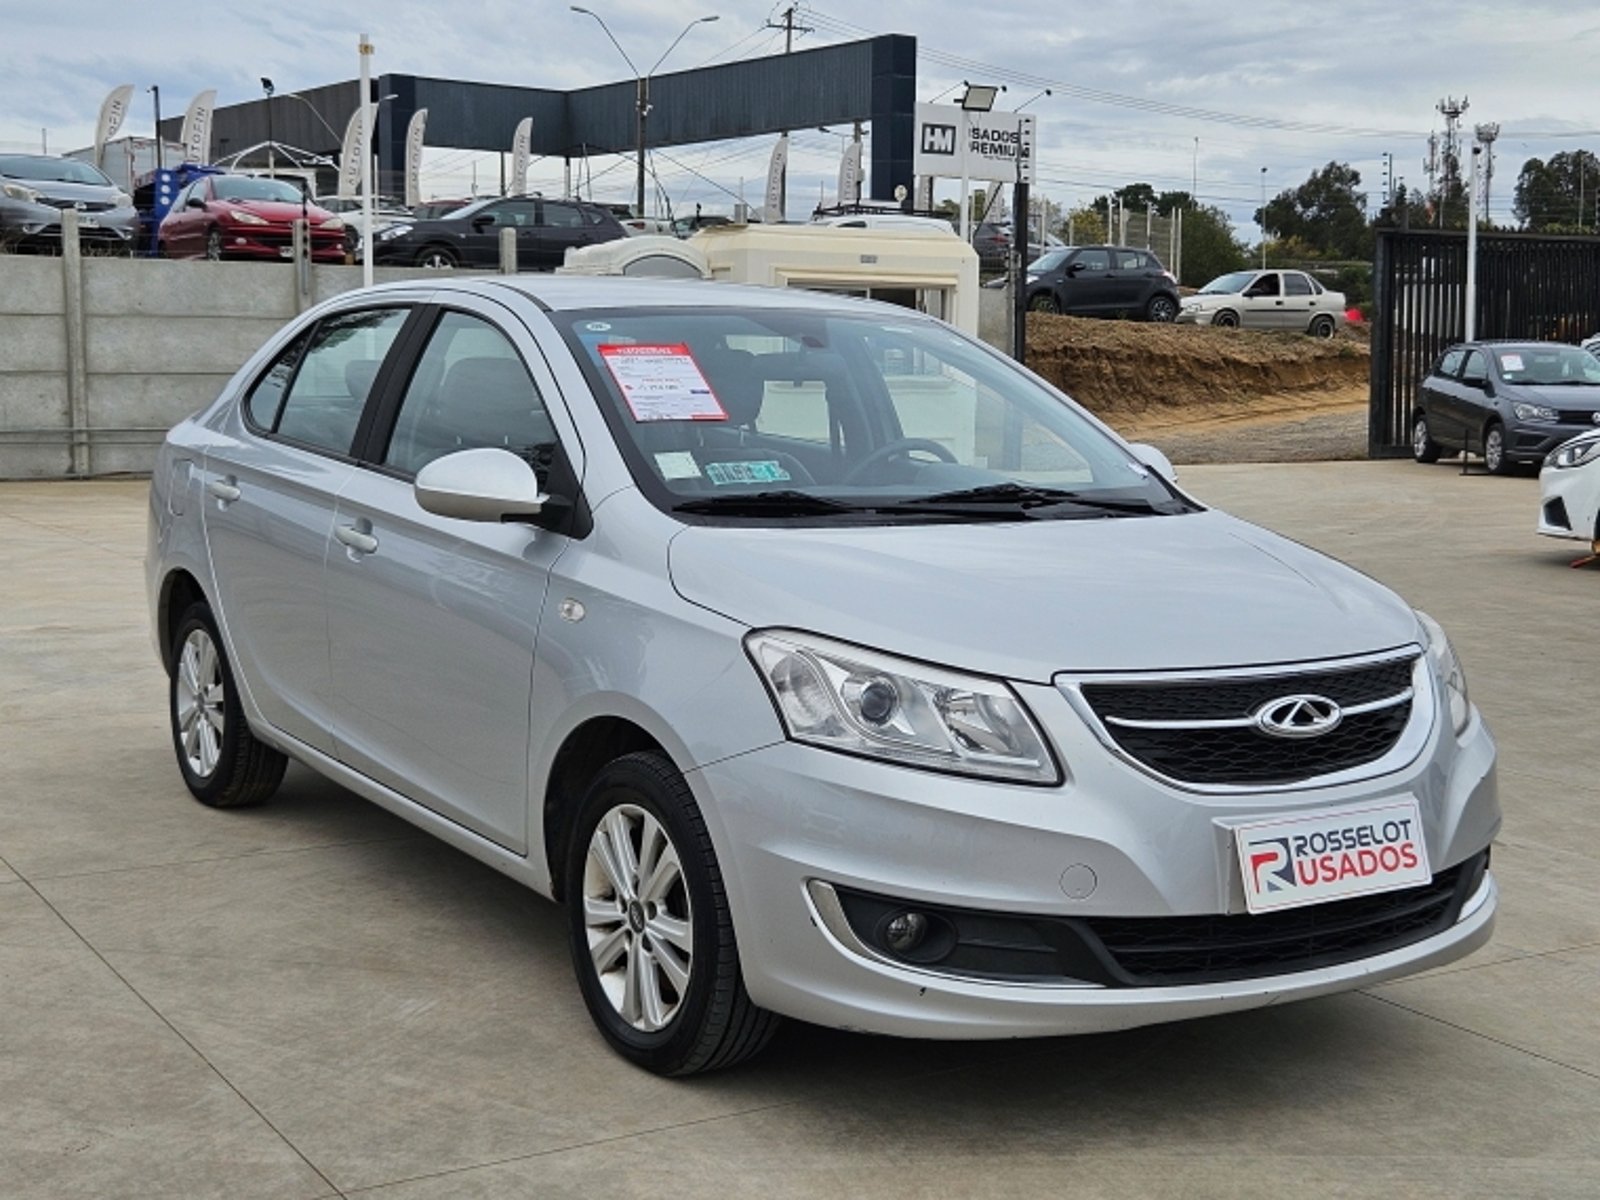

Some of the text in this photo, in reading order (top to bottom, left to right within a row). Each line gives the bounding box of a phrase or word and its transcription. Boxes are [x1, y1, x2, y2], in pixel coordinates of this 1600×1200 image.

[105, 100, 121, 138] OFIN
[923, 125, 955, 154] HM
[1293, 819, 1411, 857] ROSSELOT
[1297, 842, 1418, 886] USADOS
